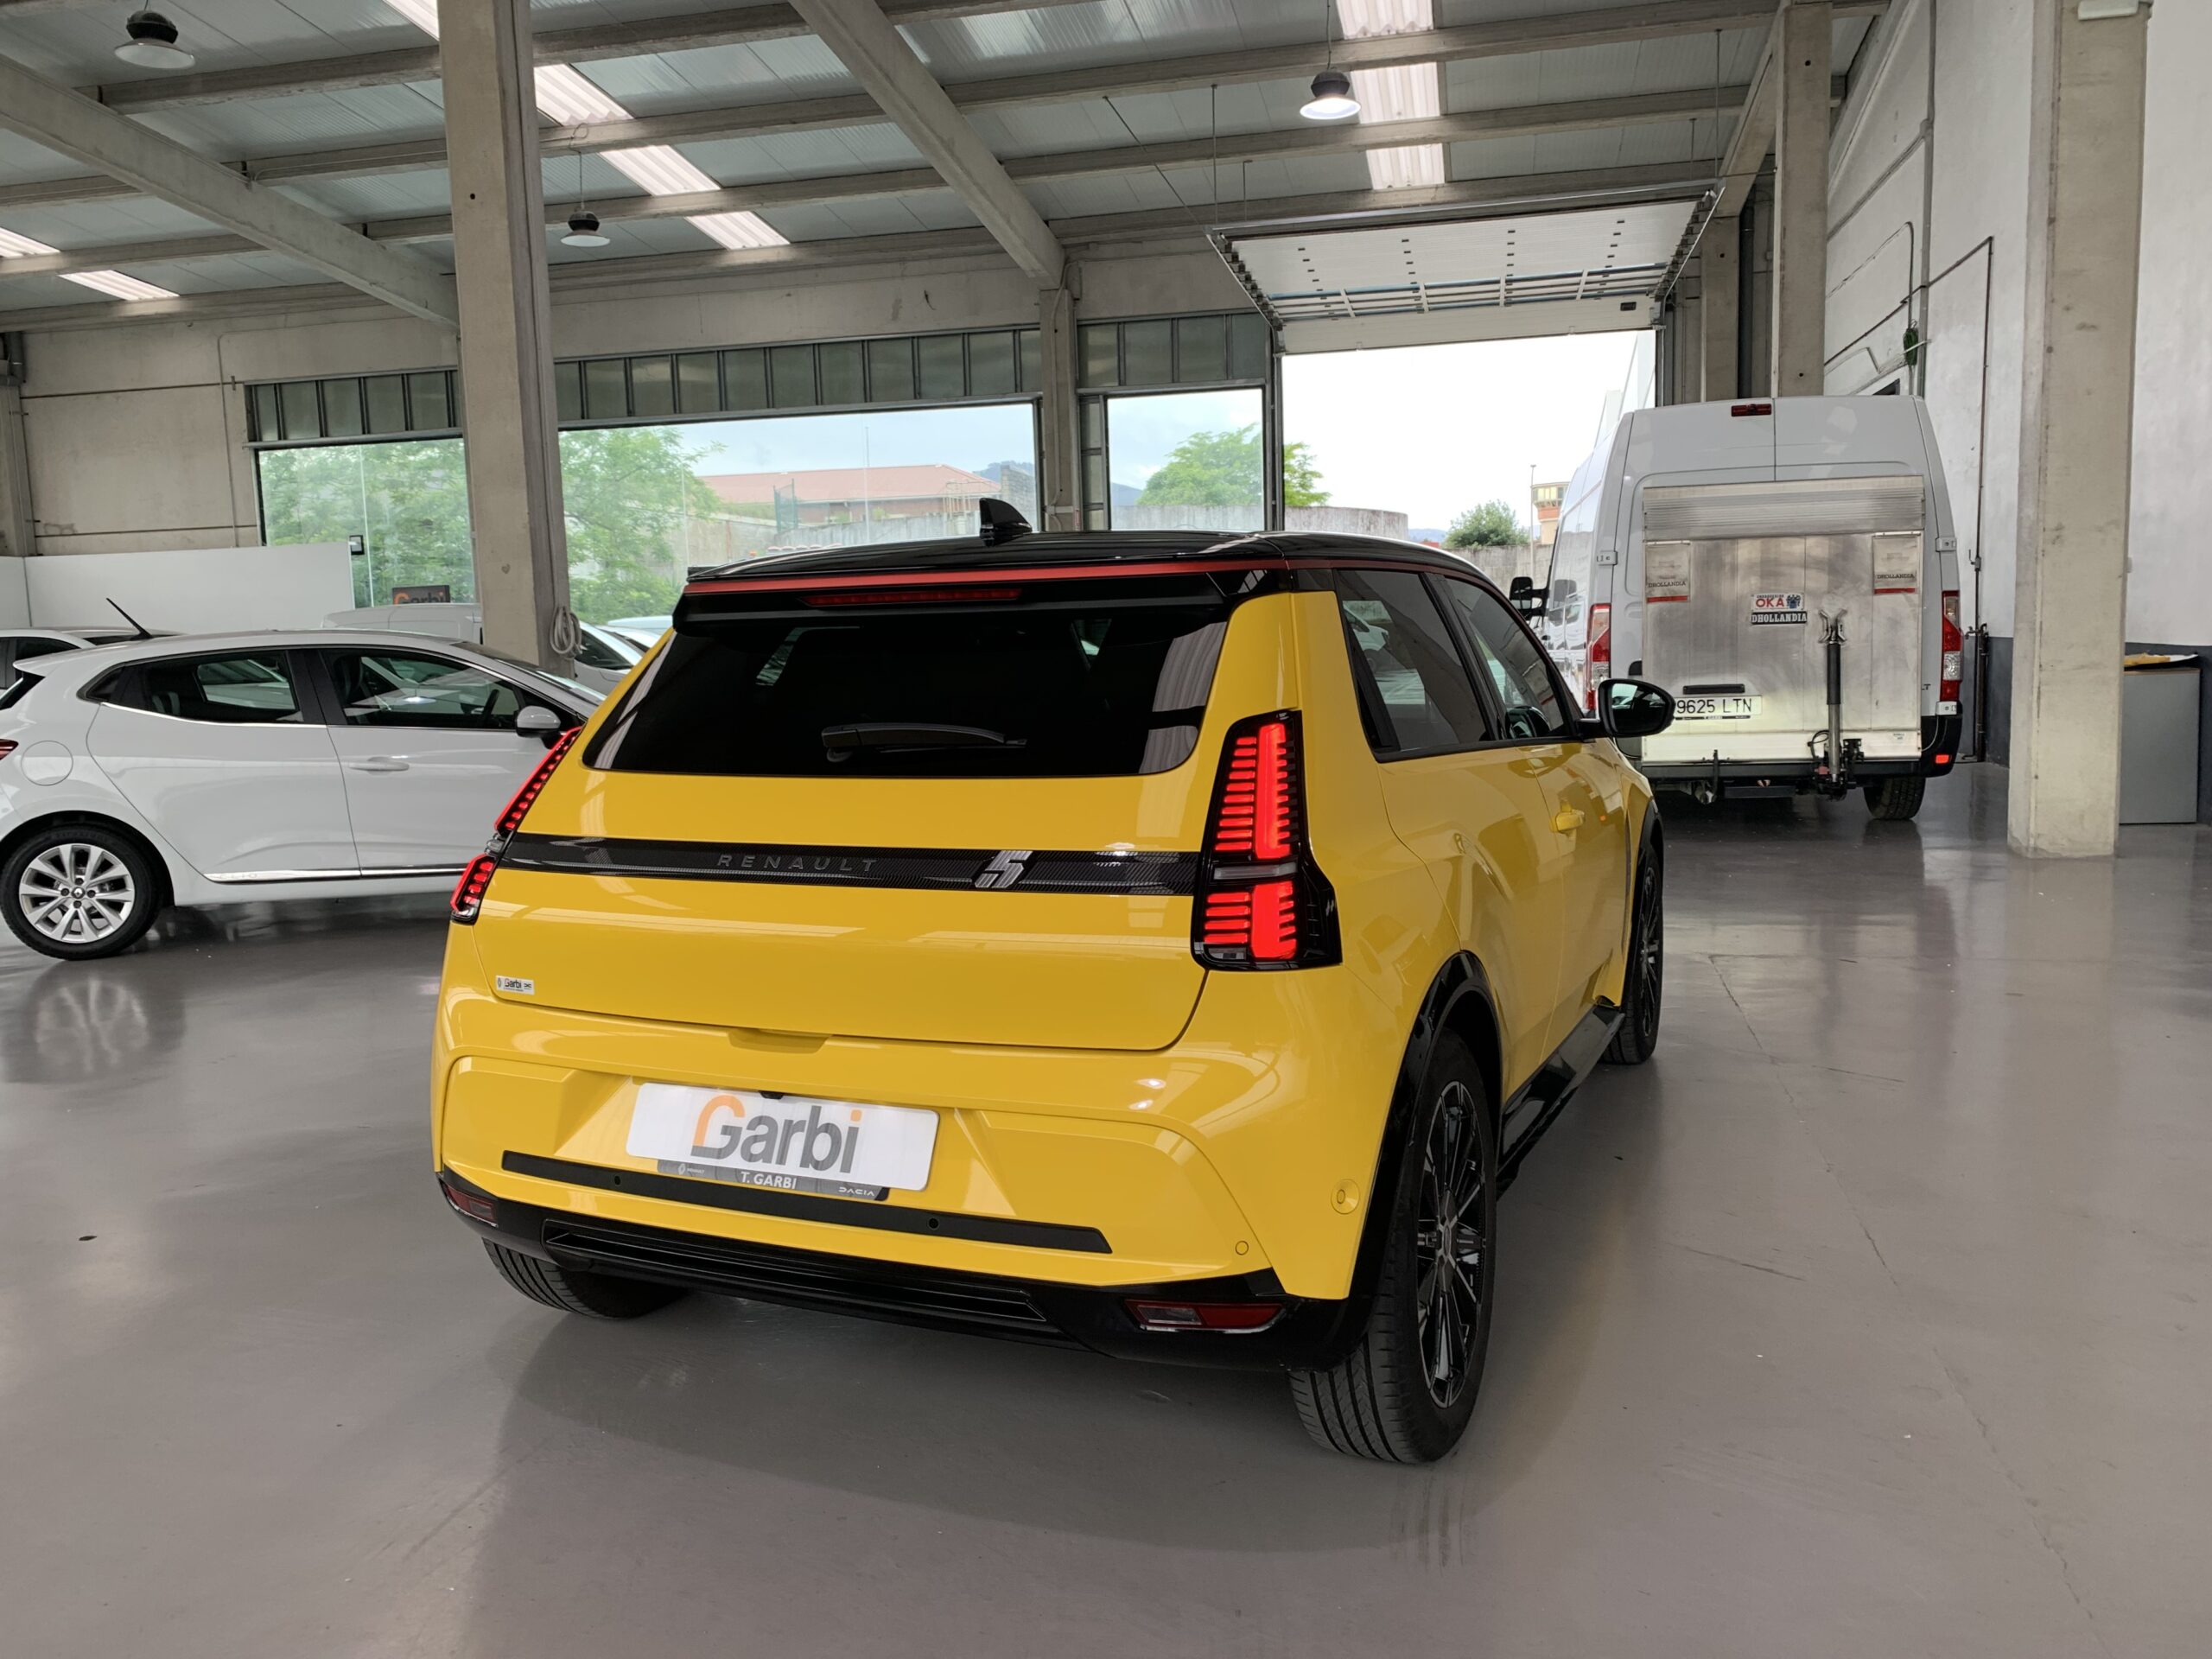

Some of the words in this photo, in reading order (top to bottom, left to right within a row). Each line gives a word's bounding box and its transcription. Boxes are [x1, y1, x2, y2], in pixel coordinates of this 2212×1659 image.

[1756, 597, 1784, 607] OKA
[1751, 613, 1807, 623] DHOLLANDIA
[1676, 699, 1715, 714] 9625
[1723, 698, 1751, 713] LTN
[716, 854, 877, 872] RENAULT
[974, 850, 1033, 888] 5
[690, 1094, 862, 1174] Garbi
[740, 1171, 750, 1184] T.
[753, 1173, 798, 1190] GARBI
[838, 1186, 875, 1197] DACIA
